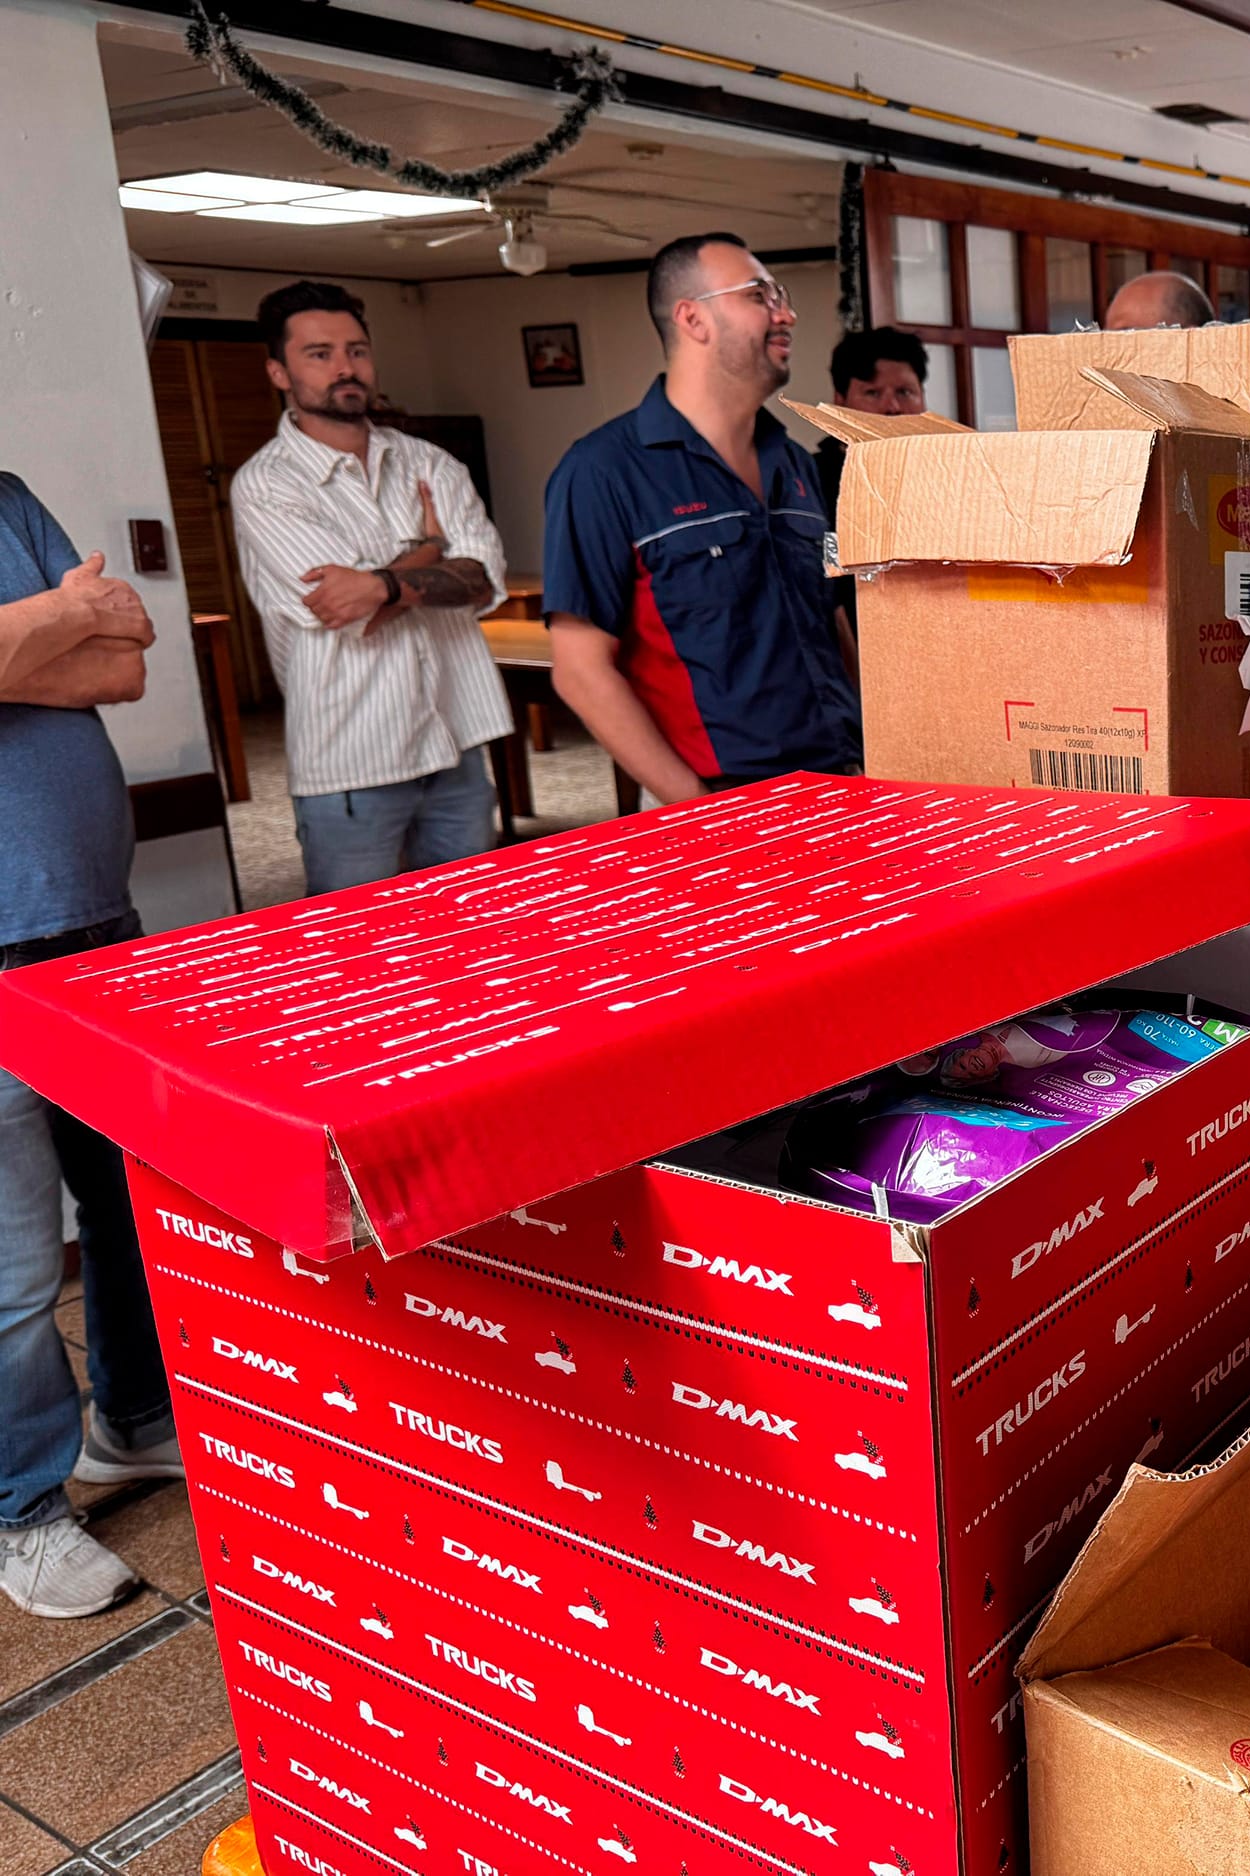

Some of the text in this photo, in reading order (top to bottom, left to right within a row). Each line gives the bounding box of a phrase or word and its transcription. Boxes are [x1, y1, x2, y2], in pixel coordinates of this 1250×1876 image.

[1019, 721, 1040, 730] MAGGI
[1040, 722, 1071, 733] Sazonador
[1073, 725, 1085, 734] Res
[1086, 726, 1098, 735] Tira
[175, 972, 343, 1013] TRUCKS
[259, 998, 440, 1048] TRUCKS
[363, 1026, 560, 1088] TRUCKS
[156, 1208, 254, 1258] TRUCKS
[1010, 1198, 1105, 1279] D-MAX
[662, 1241, 794, 1297] D-MAX
[404, 1292, 508, 1344] D-MAX
[212, 1336, 300, 1384] D-MAX
[389, 1402, 504, 1464] TRUCKS
[672, 1382, 799, 1442] D-MAX
[976, 1350, 1086, 1457] TRUCKS
[199, 1433, 296, 1490] TRUCKS
[252, 1555, 337, 1607] D-MAX
[441, 1536, 543, 1594] D-MAX
[692, 1520, 817, 1585] D-MAX
[238, 1640, 332, 1703] TRUCKS
[425, 1633, 537, 1702] TRUCKS
[699, 1647, 822, 1716] D-MAX
[289, 1757, 372, 1815] D-MAX
[475, 1762, 573, 1825] D-MAX
[718, 1774, 839, 1847] D-MAX
